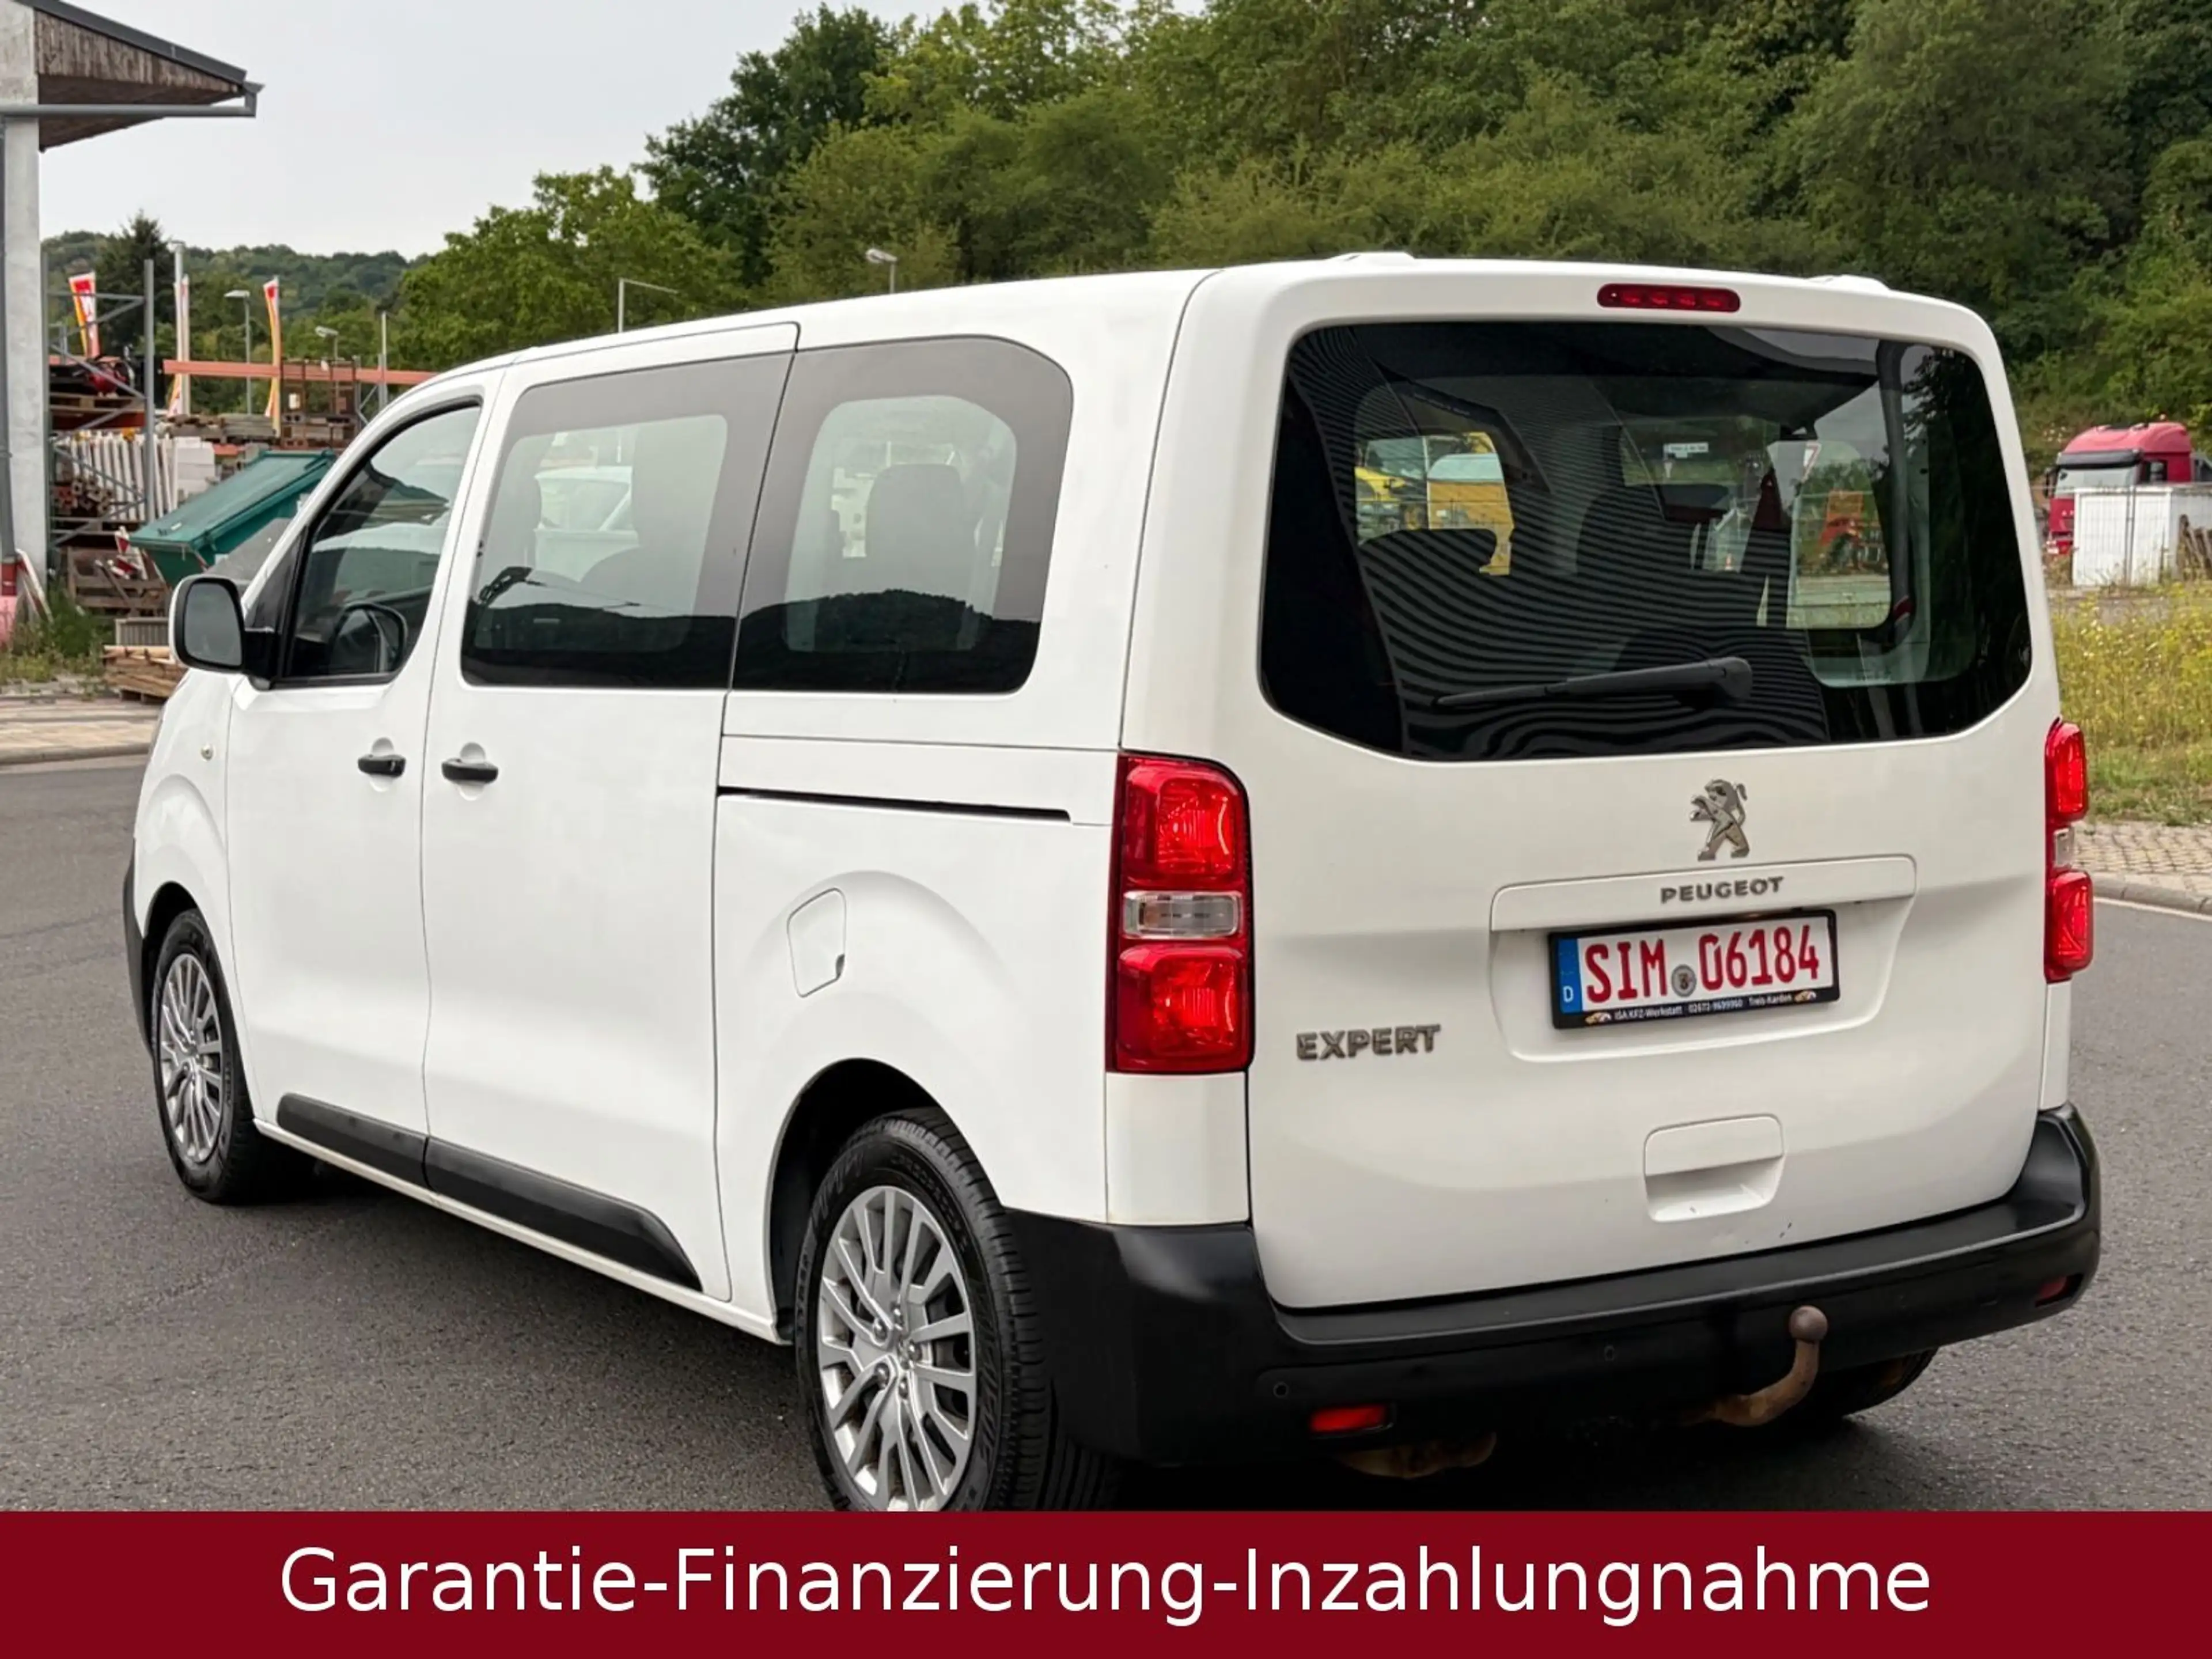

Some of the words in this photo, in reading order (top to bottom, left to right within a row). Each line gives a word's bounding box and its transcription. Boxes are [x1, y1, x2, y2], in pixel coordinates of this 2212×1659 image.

[1660, 876, 1785, 904] PEUGEOT
[1563, 986, 1573, 1002] D
[1585, 938, 1668, 1003] SIM
[1699, 924, 1820, 991] 06184
[1296, 1023, 1441, 1060] EXPERT
